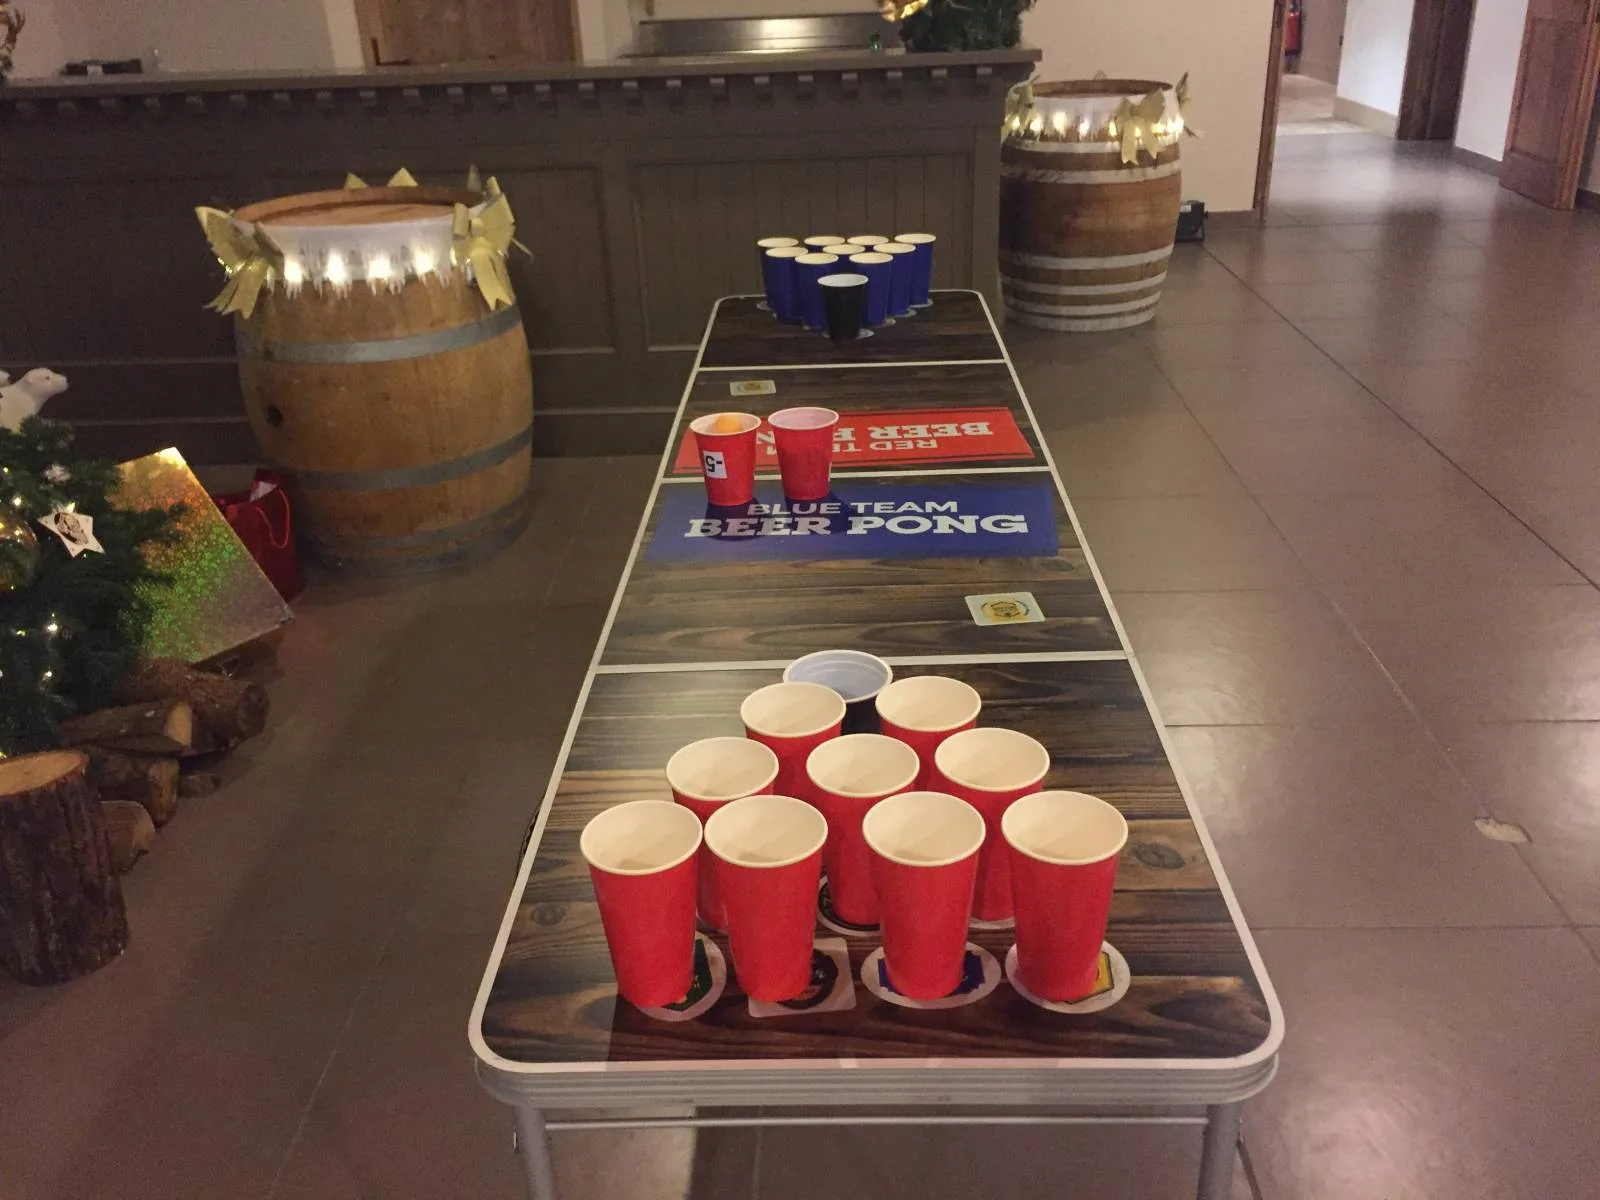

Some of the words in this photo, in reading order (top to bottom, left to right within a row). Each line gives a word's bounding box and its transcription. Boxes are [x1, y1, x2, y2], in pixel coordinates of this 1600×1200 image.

[868, 421, 994, 440] BEER
[869, 439, 938, 451] RED
[705, 455, 723, 473] -5
[747, 502, 842, 515] BLUE
[850, 500, 958, 514] TEAM
[684, 516, 832, 538] BEER
[846, 514, 1029, 535] PONG
